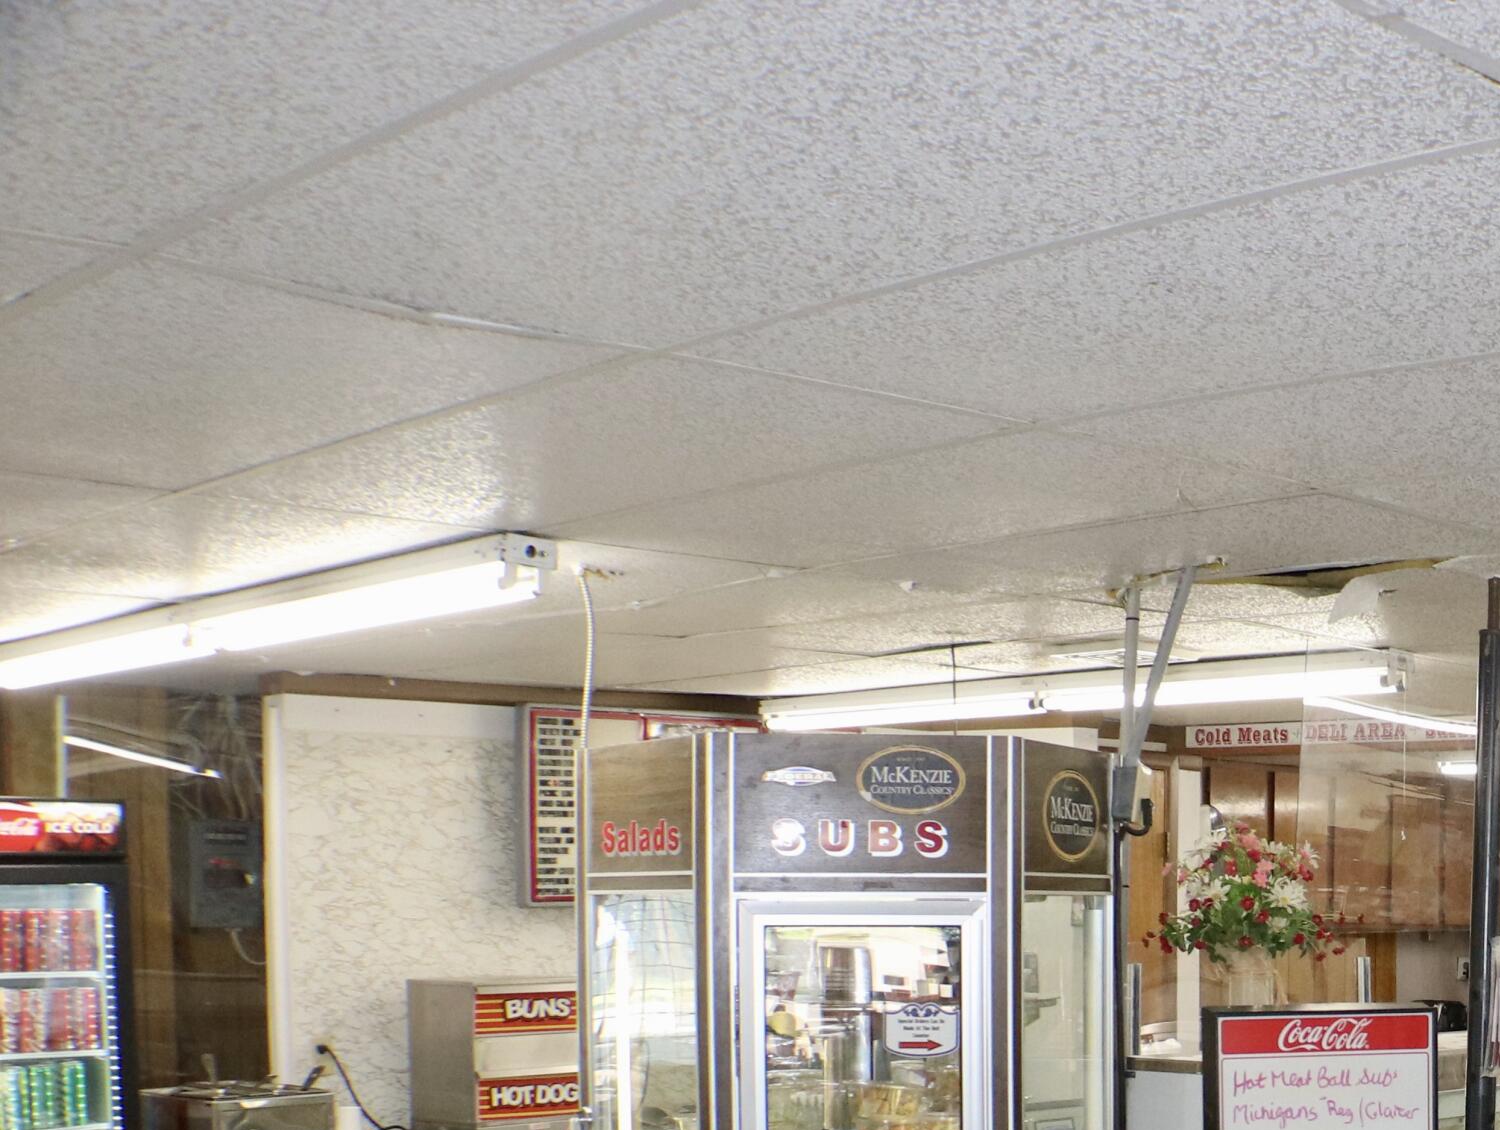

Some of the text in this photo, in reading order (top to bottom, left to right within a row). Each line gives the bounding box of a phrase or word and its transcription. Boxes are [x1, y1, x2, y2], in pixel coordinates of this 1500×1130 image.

[1194, 728, 1232, 746] Cold
[1237, 727, 1289, 745] Meats
[1304, 723, 1348, 741] DELI
[1353, 721, 1408, 741] AREA
[870, 765, 953, 784] McKENZIE
[1050, 795, 1094, 823] McKENZIE
[45, 822, 73, 834] ICE
[75, 822, 115, 834] COLD
[601, 817, 682, 857] Salads
[771, 818, 948, 858] SUBS
[504, 998, 571, 1019] BUNS
[1277, 1017, 1373, 1052] Coca-Cola
[1233, 1070, 1267, 1097] Hot
[1271, 1069, 1312, 1088] Meat
[1316, 1066, 1352, 1089] Ball
[490, 1085, 535, 1107] HOT
[1232, 1102, 1318, 1129] Michigans
